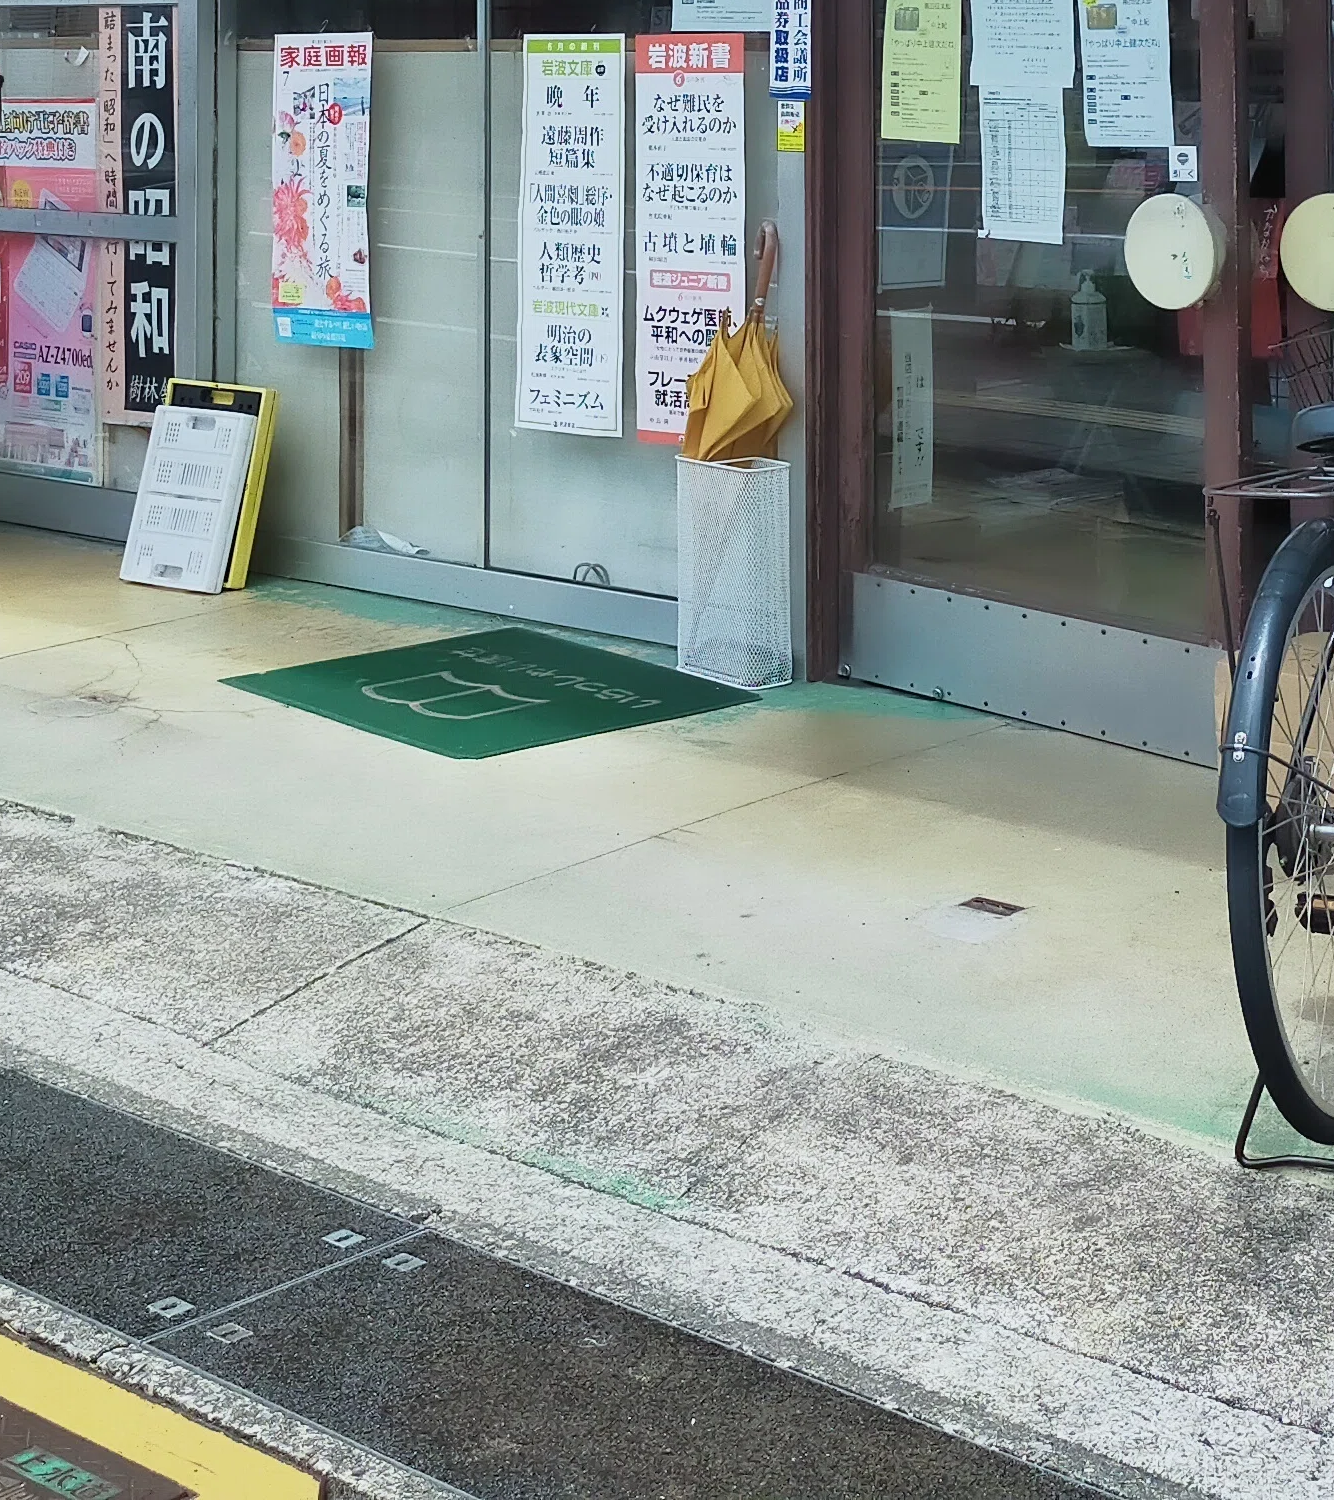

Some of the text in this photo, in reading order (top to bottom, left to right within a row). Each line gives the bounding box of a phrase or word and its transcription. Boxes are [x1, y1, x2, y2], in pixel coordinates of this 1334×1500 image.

[279, 44, 368, 69] 家庭画報
[648, 42, 731, 69] 岩波新書
[541, 59, 593, 77] 岩波文庫
[546, 84, 600, 109] 晩年
[653, 93, 725, 114] なぜ難民を
[641, 114, 737, 135] 受け入れるのか
[541, 125, 605, 147] 遠藤周作
[547, 147, 596, 170] 短篇集
[315, 82, 334, 281] 日本の夏をめぐる旅
[645, 162, 733, 183] 不適切保育は
[641, 182, 738, 204] なぜ起こるのか
[536, 205, 605, 228] 金色の眼の娘
[538, 241, 602, 265] 人類歴史
[642, 230, 737, 257] 古墳と埴輪
[651, 271, 728, 290] 岩波ジュニア新書
[532, 299, 600, 318] 岩波現代文庫
[13, 341, 37, 350] CASIO
[546, 324, 593, 346] 明治の
[647, 370, 692, 388] フレー
[528, 387, 605, 411] フェミニズム
[450, 646, 663, 709] いらっしゃいませ
